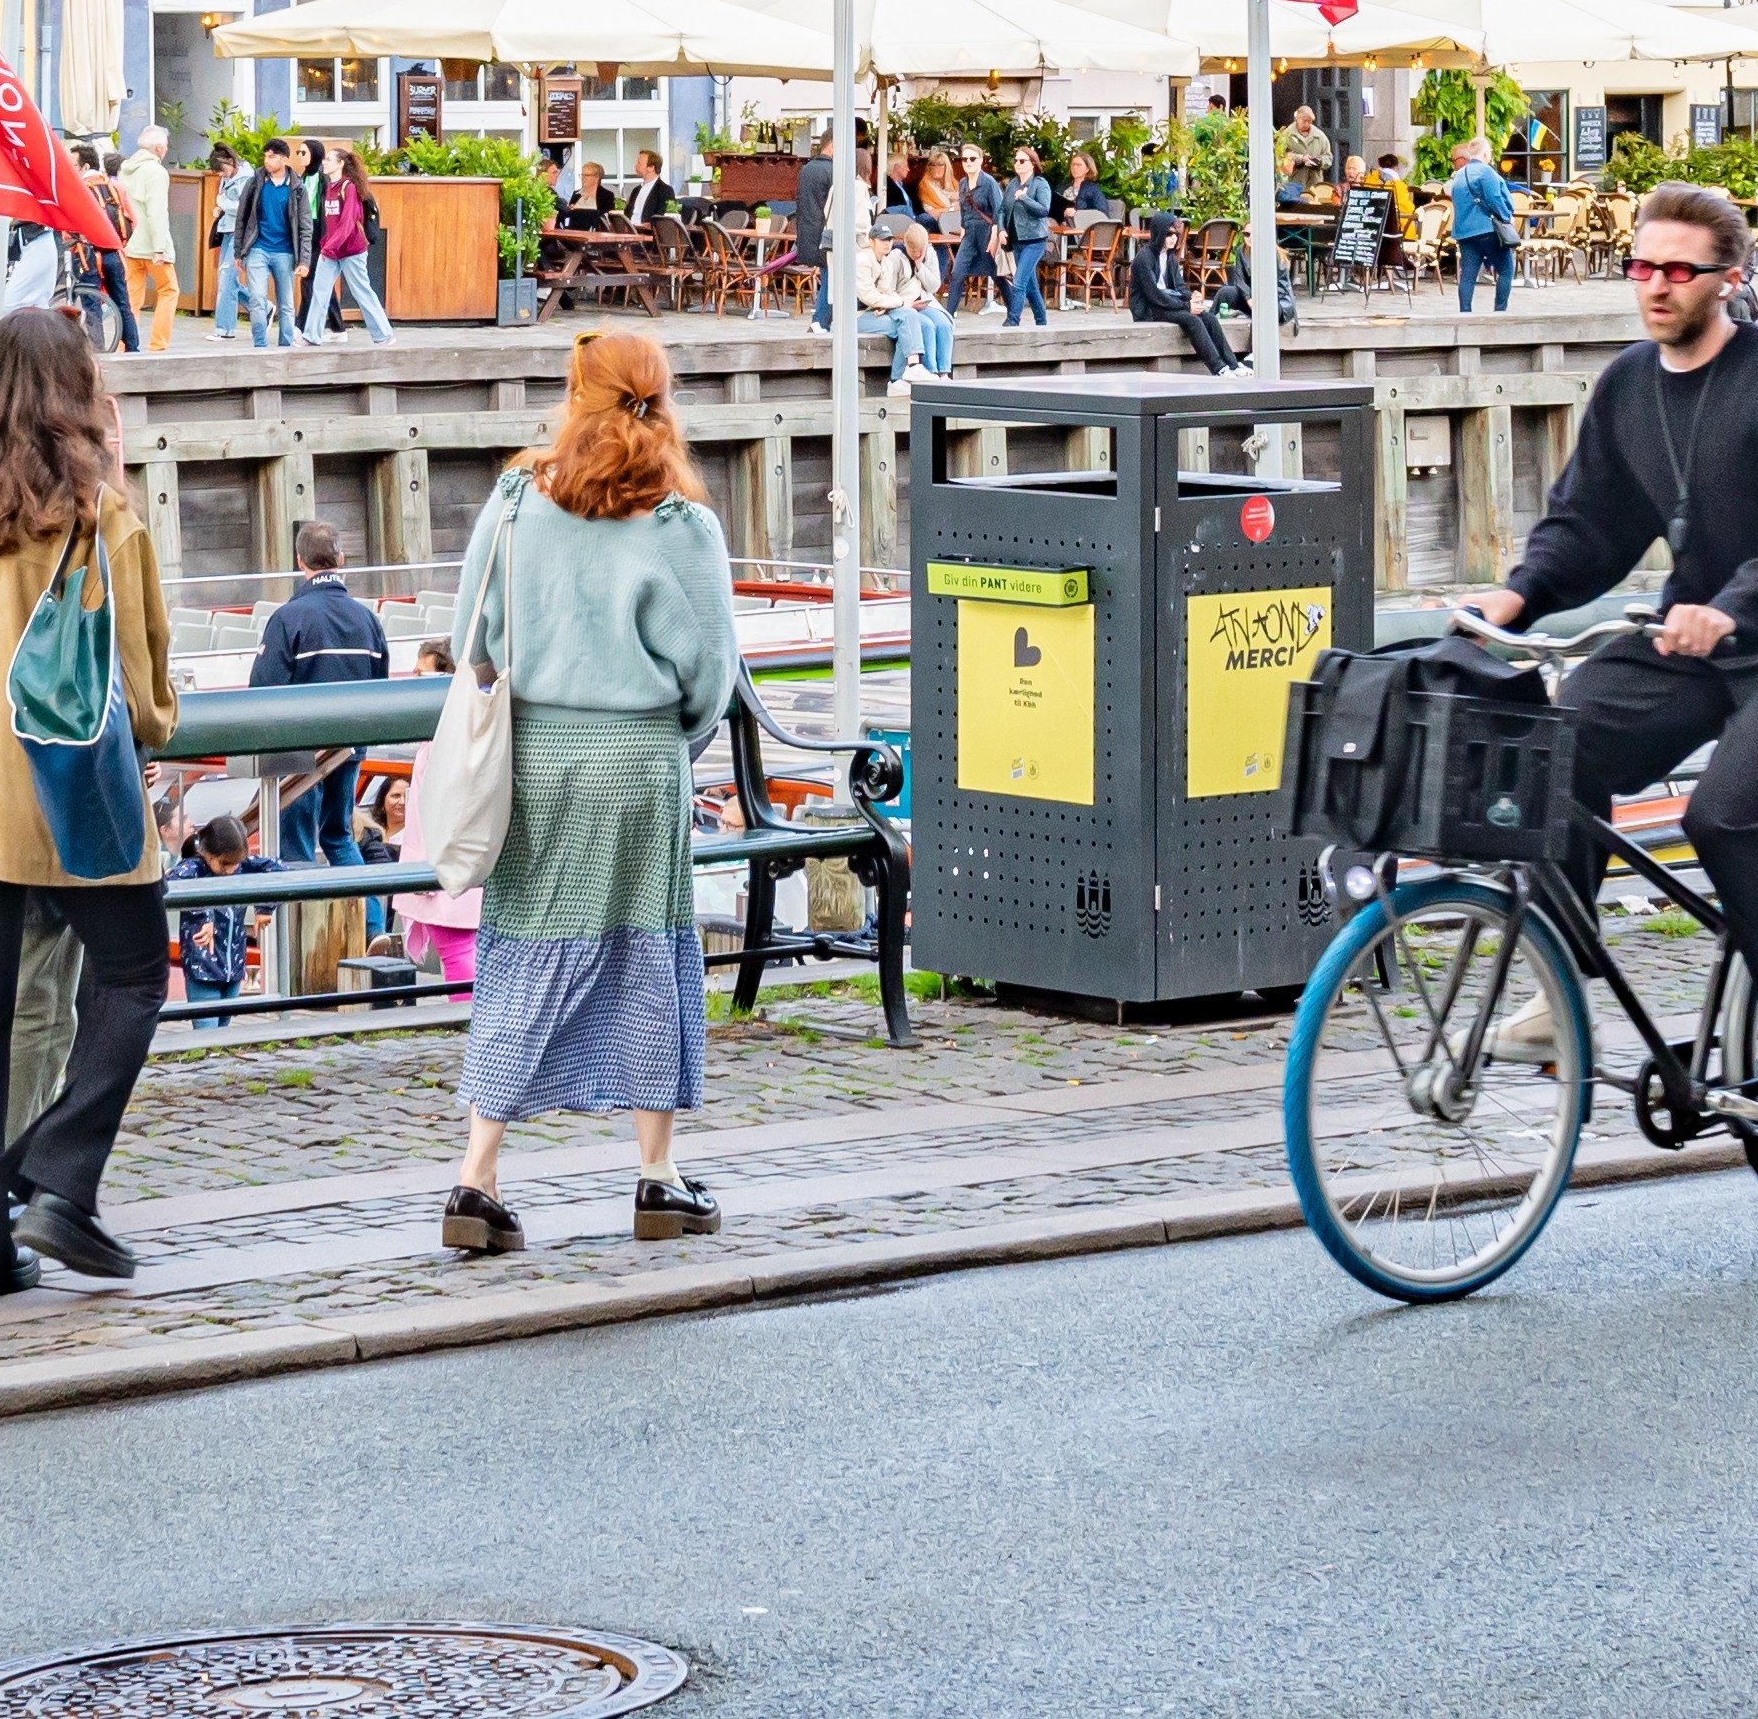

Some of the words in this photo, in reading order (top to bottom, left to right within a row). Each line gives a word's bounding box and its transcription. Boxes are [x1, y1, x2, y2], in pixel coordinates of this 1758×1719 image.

[944, 573, 959, 586] Giv
[962, 575, 978, 588] din
[980, 576, 1007, 591] PANT
[1009, 581, 1042, 594] videre
[1225, 646, 1294, 671] MERCI
[1023, 700, 1037, 709] Kbh
